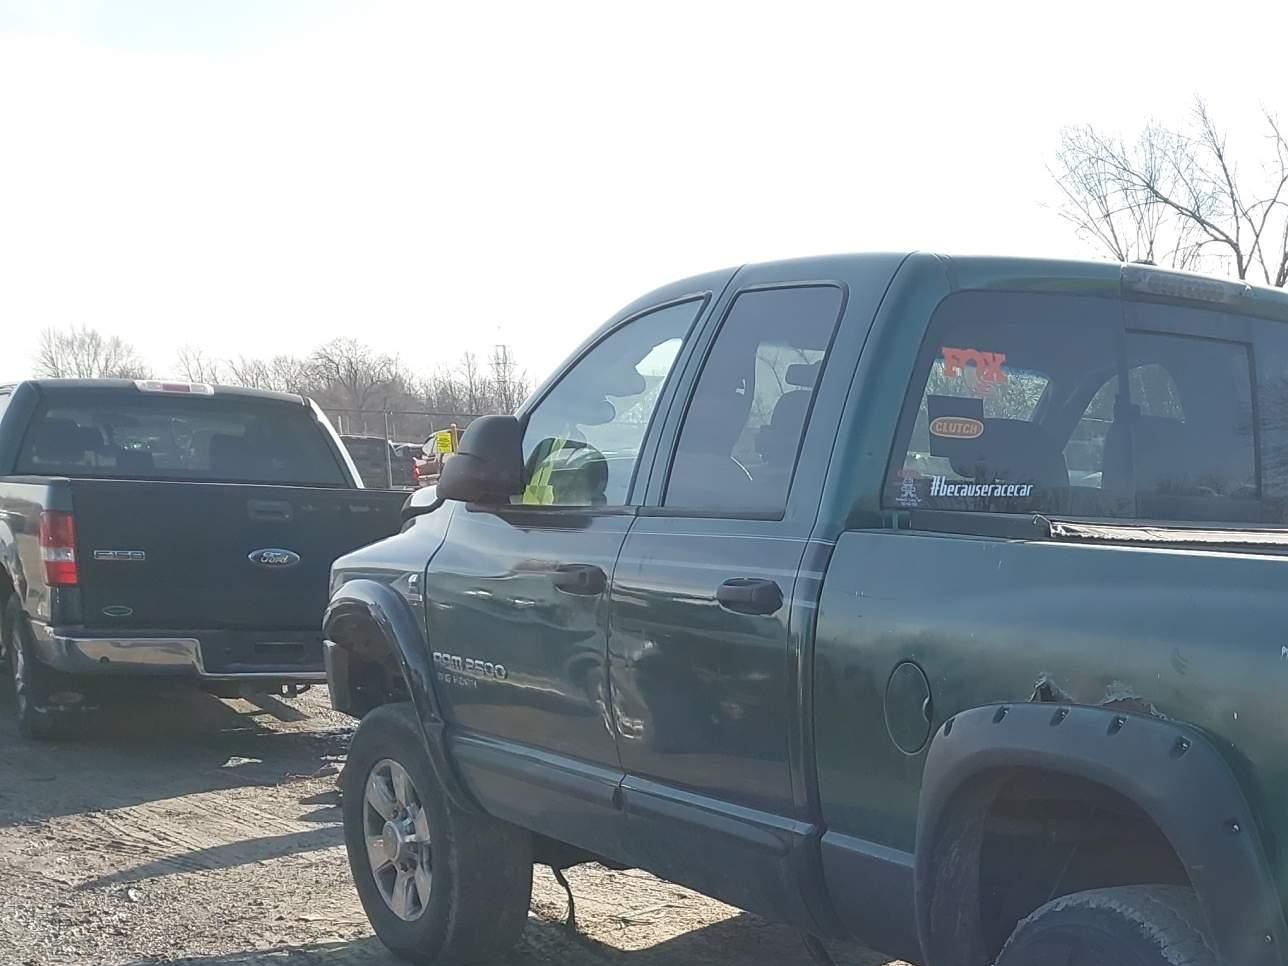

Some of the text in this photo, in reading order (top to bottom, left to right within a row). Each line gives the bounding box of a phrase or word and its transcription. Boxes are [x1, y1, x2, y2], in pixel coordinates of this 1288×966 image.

[941, 347, 1009, 390] FOX
[935, 421, 978, 435] CLUTCH
[930, 476, 1034, 497] #becauseracecar
[260, 551, 289, 565] Ford
[466, 658, 507, 680] 2500
